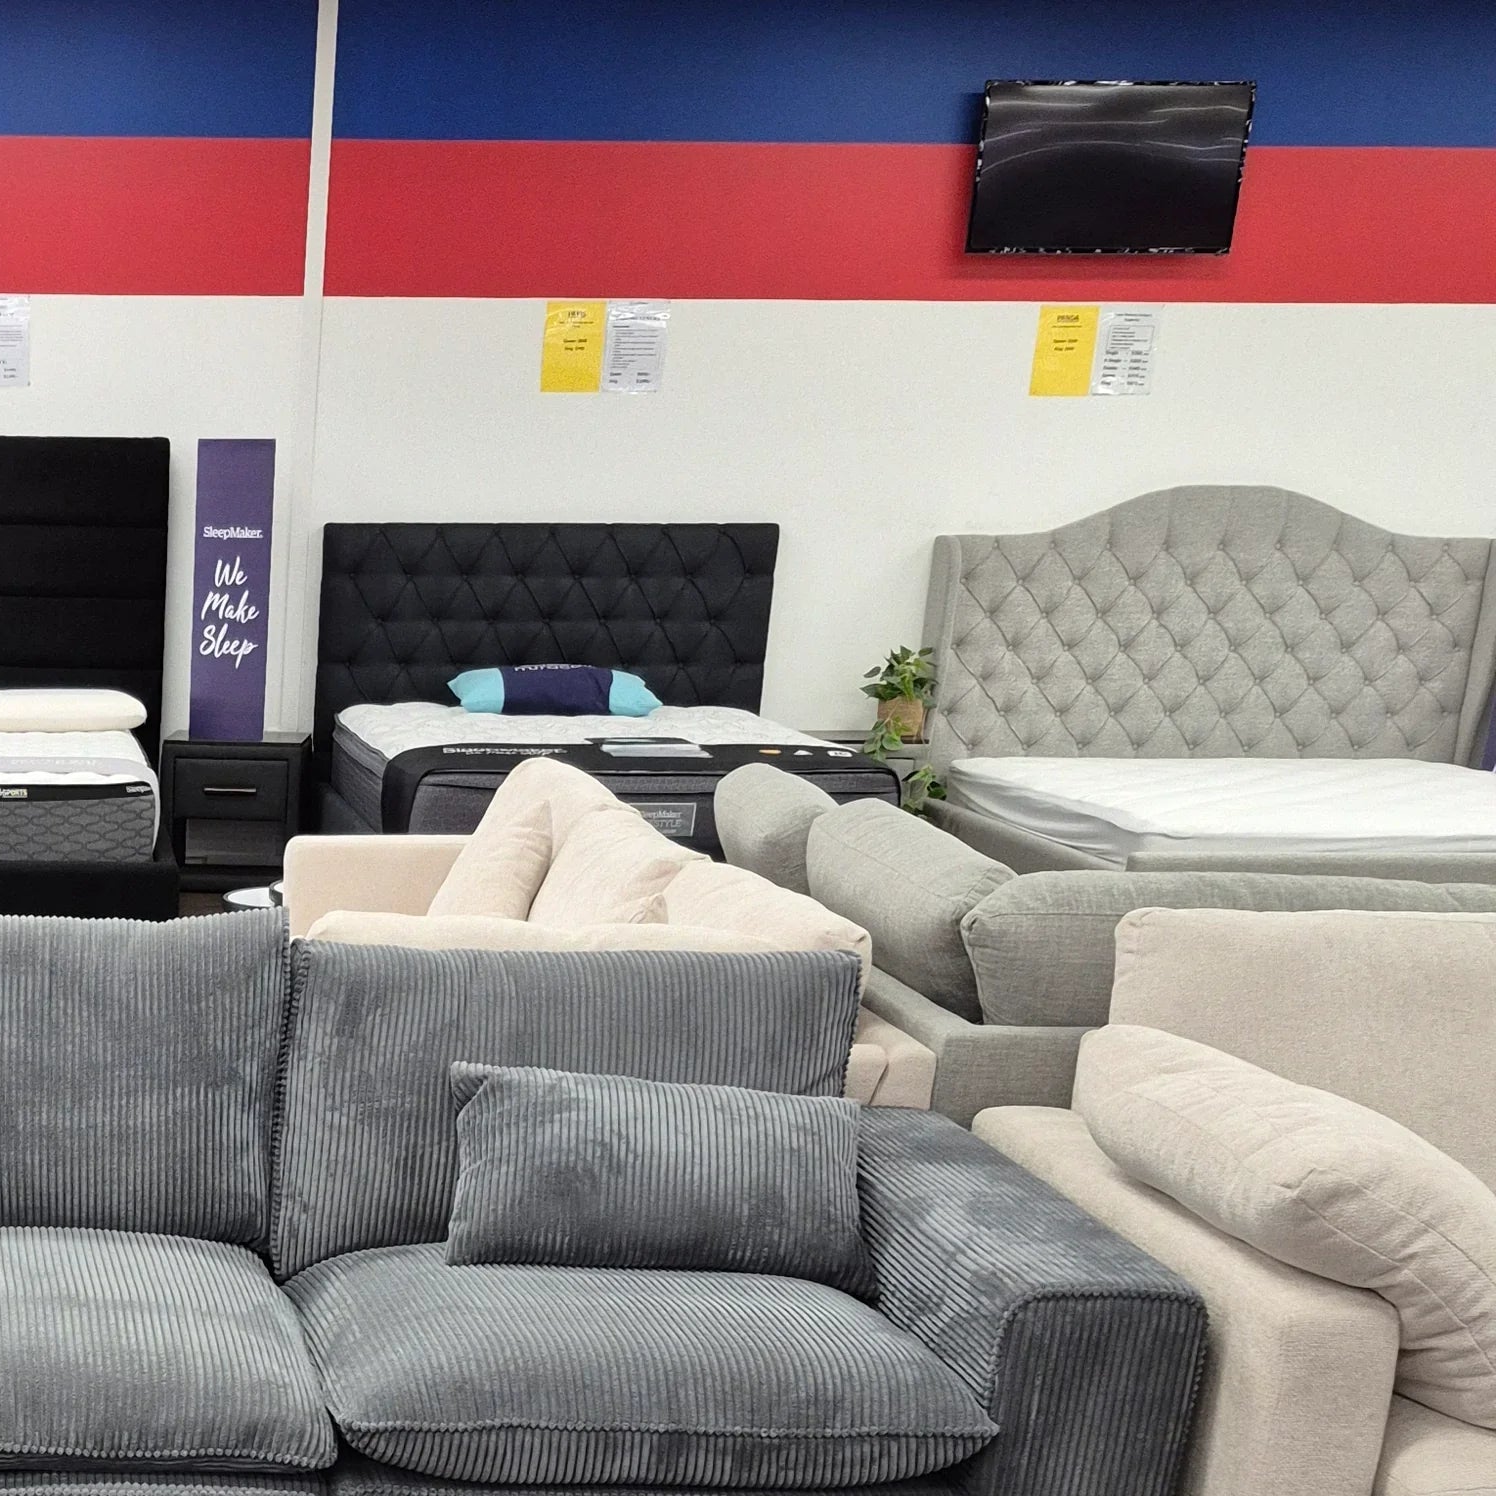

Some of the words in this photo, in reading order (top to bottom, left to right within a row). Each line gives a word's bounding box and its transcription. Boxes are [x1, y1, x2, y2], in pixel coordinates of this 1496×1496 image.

[214, 556, 248, 587] We
[201, 590, 260, 623] Make
[199, 623, 258, 669] Sleep
